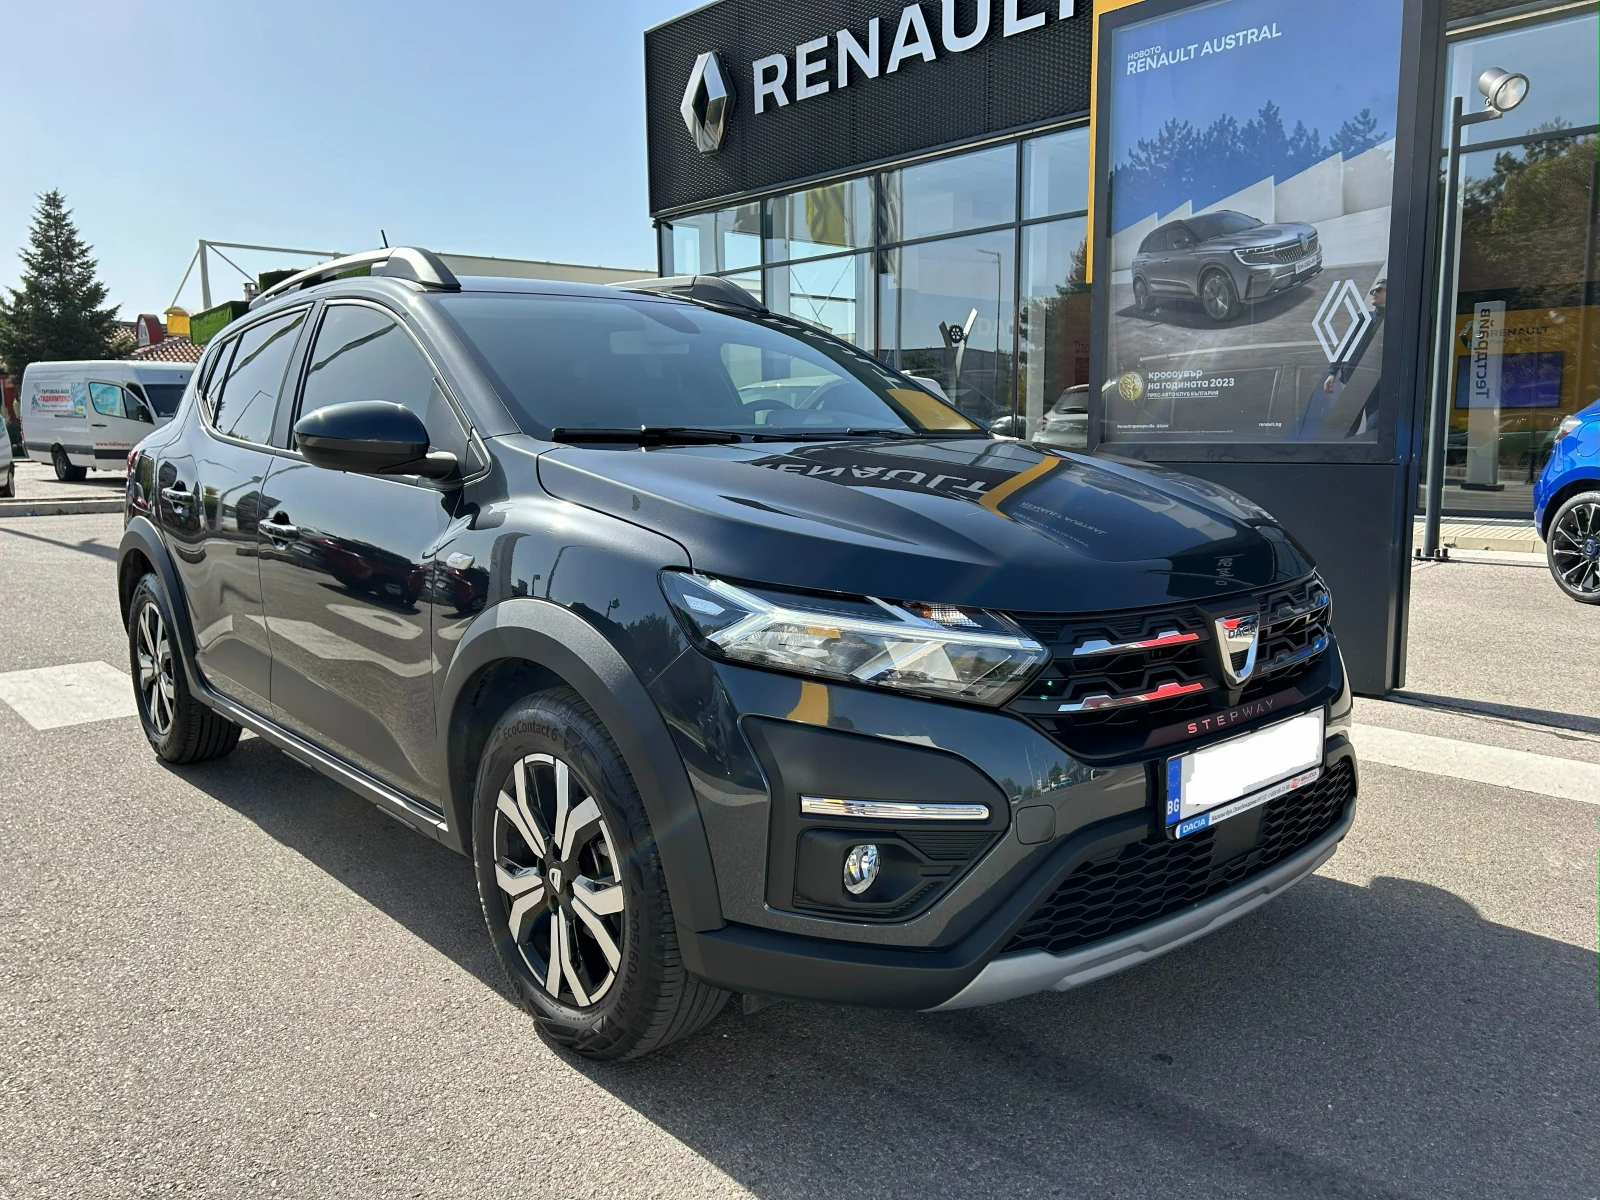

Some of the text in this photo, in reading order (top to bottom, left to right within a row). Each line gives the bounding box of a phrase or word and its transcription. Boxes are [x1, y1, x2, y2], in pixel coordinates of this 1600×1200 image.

[1126, 22, 1282, 76] RENAULT AUSTRAL
[1127, 45, 1162, 62] НОВОТО
[1147, 377, 1235, 390] на годината 2023
[1148, 369, 1203, 381] кросоувър
[1228, 624, 1256, 640] DACIA
[1187, 698, 1274, 735] STEPWAY
[503, 720, 559, 742] EcoContact 6
[1166, 797, 1180, 816] BG
[1181, 817, 1206, 834] DACIA
